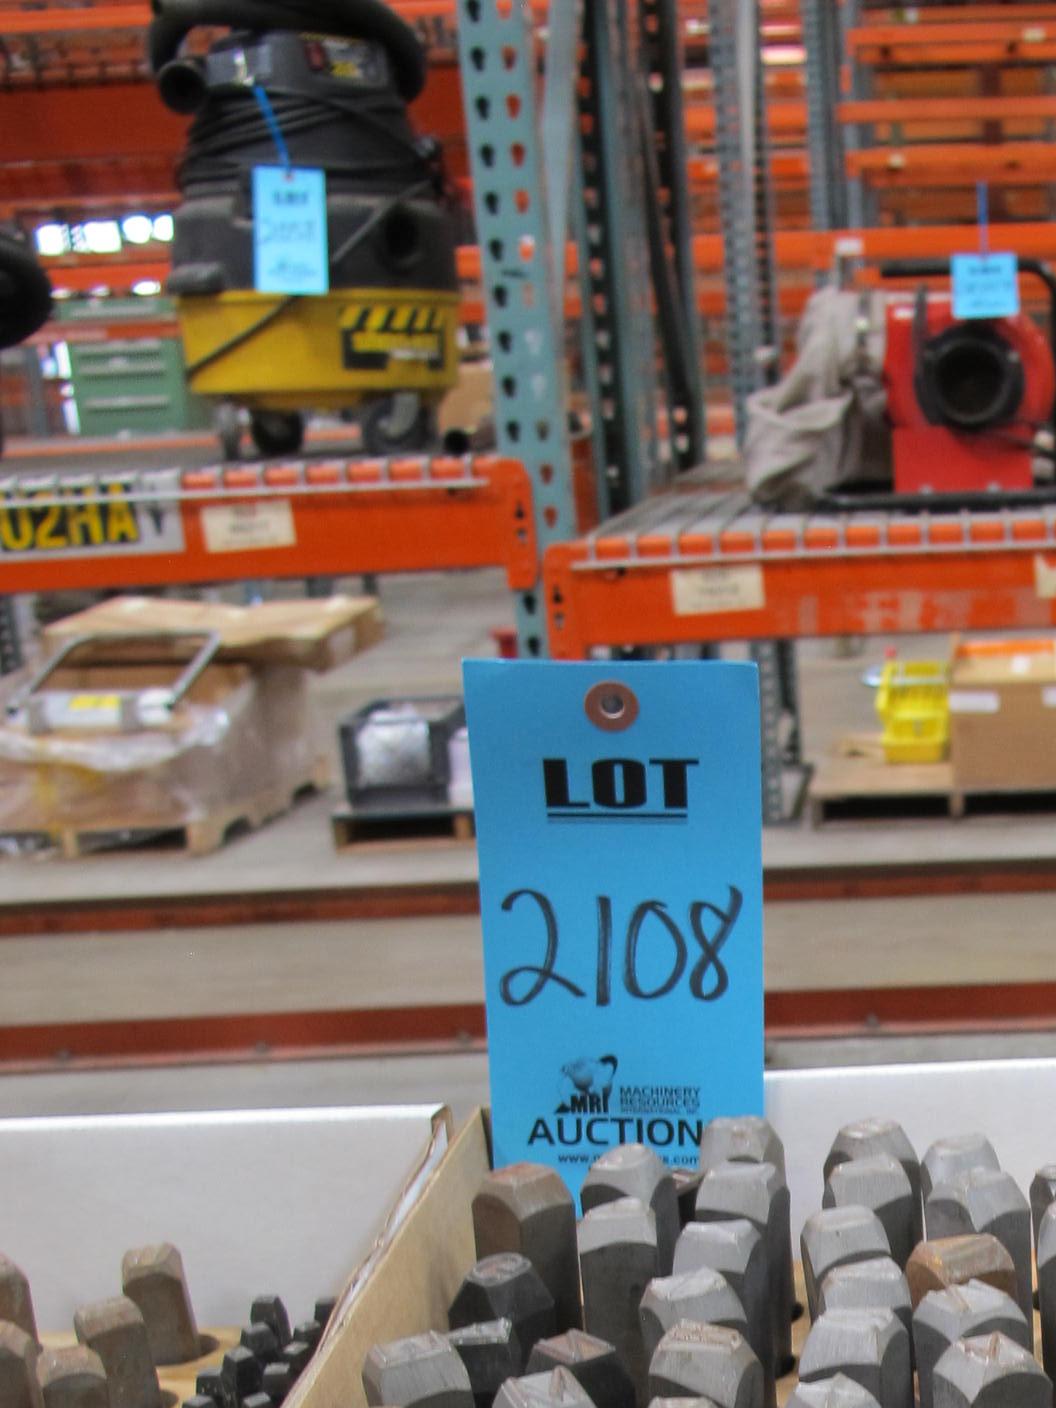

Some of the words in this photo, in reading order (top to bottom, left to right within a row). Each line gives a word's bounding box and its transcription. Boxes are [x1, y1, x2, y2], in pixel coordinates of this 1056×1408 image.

[542, 758, 699, 809] LOT
[501, 885, 743, 1006] 2108
[619, 1086, 700, 1099] MACHINERY
